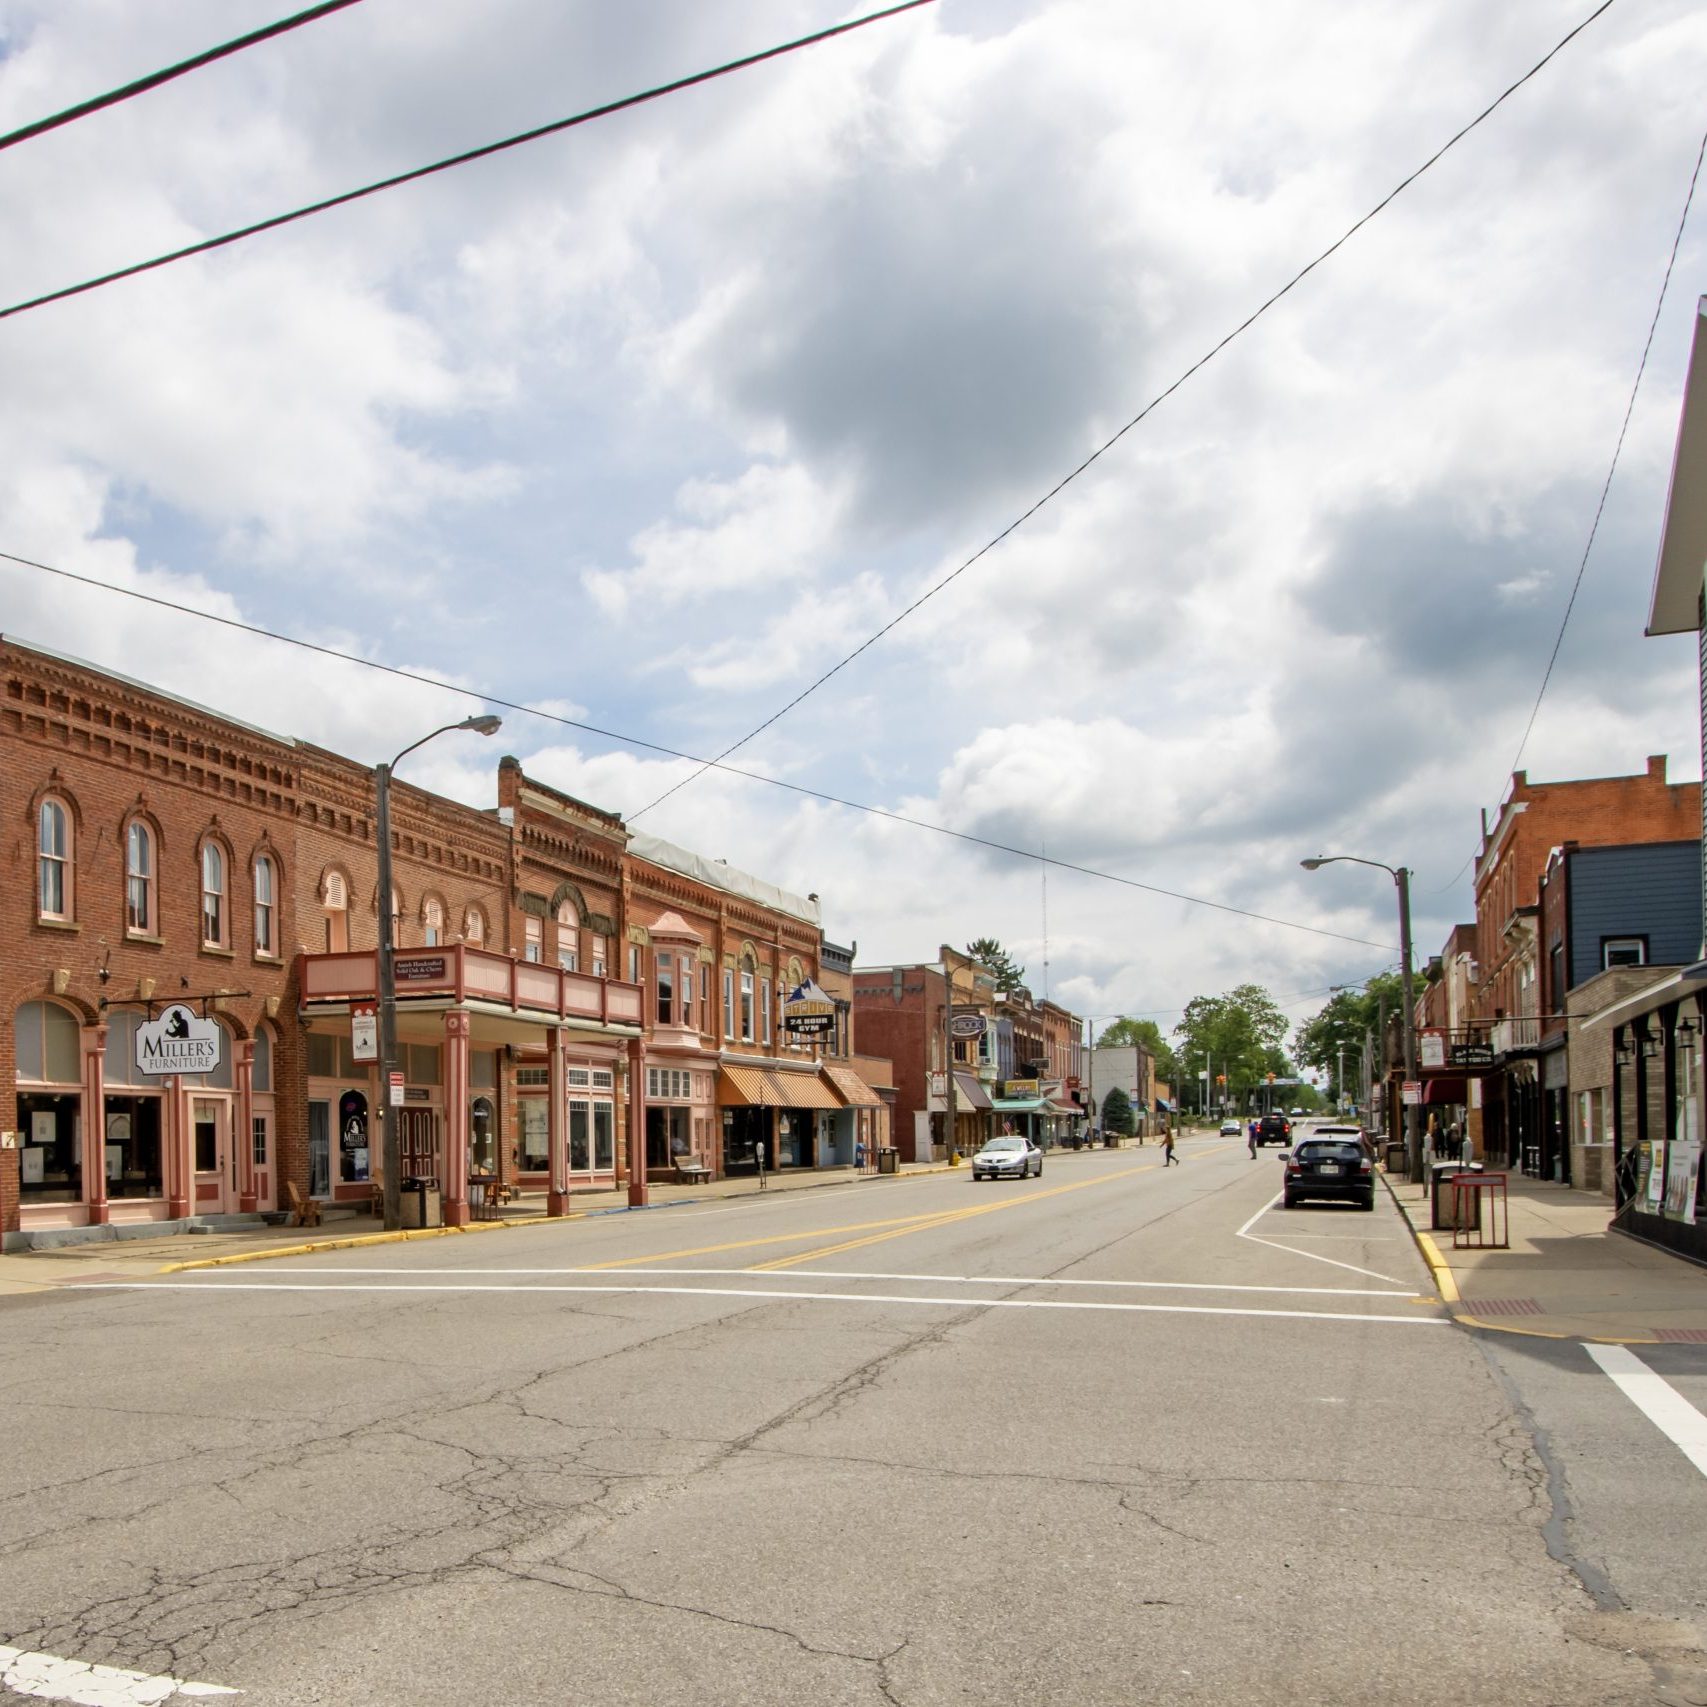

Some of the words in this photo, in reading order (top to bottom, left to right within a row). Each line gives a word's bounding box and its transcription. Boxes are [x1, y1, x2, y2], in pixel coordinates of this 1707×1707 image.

[785, 1002, 834, 1015] STRIVE
[803, 1017, 828, 1025] HOUR
[798, 1024, 819, 1032] GYM
[143, 1035, 214, 1058] MILLER'S
[149, 1057, 210, 1069] FURNITURE
